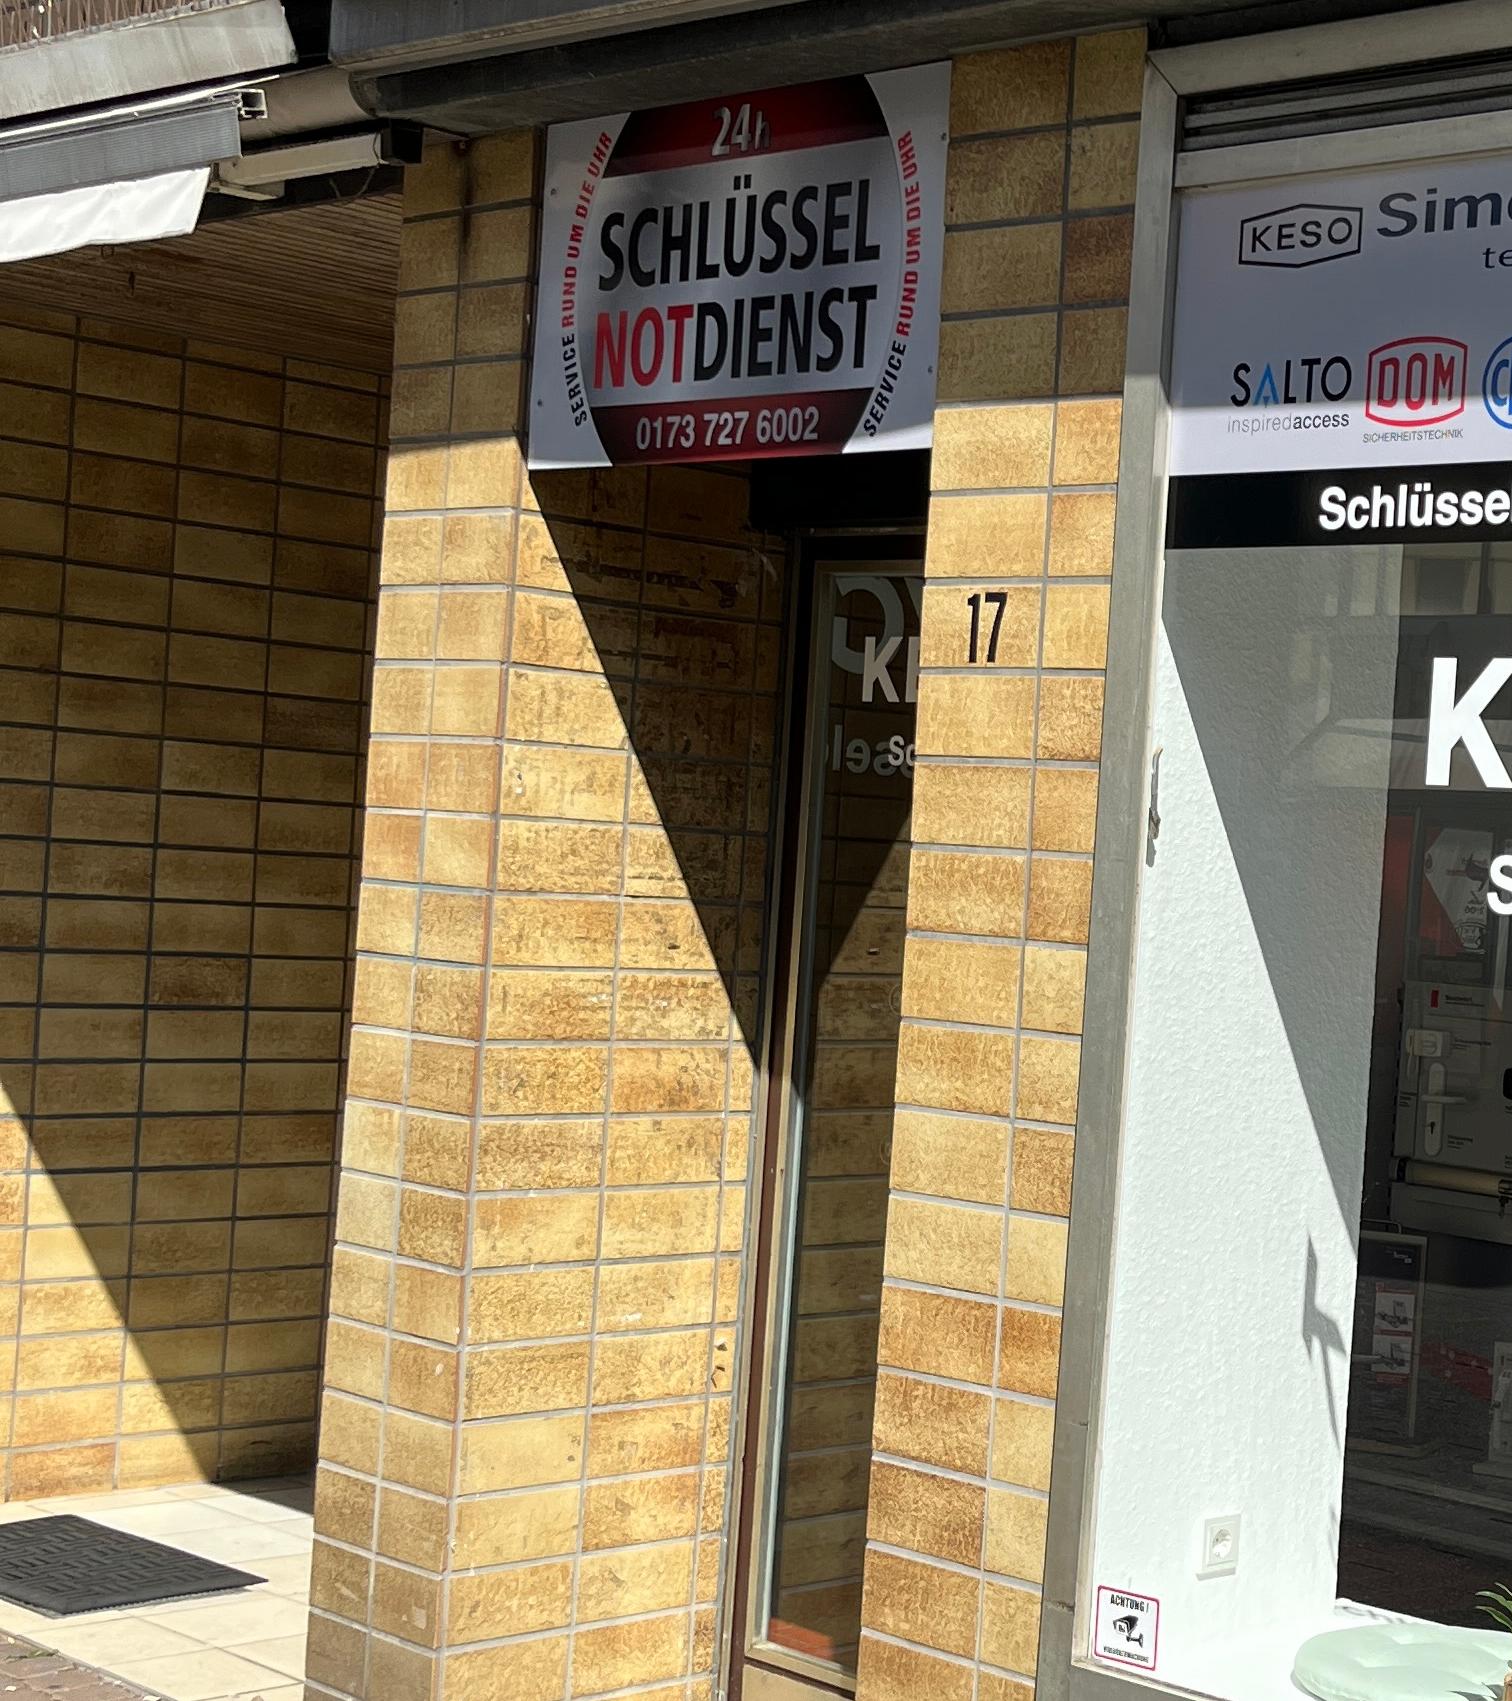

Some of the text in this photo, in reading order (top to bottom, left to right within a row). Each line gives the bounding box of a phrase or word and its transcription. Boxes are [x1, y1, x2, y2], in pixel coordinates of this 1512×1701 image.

[711, 104, 771, 157] 24h
[598, 174, 880, 292] SCHLÜSSEL
[1250, 217, 1353, 253] KESO
[562, 131, 613, 426] SERVICE RUND UM DIE UHR
[864, 131, 921, 437] SERVICE RUND UM DIE UHR
[593, 284, 878, 389] NOTDIENST
[1230, 355, 1352, 408] SALTO
[1377, 352, 1455, 410] DOM
[635, 406, 820, 450] 0173 727 6002
[1362, 429, 1464, 444] SICHERHEITSTECHNIK
[967, 592, 1008, 663] 17
